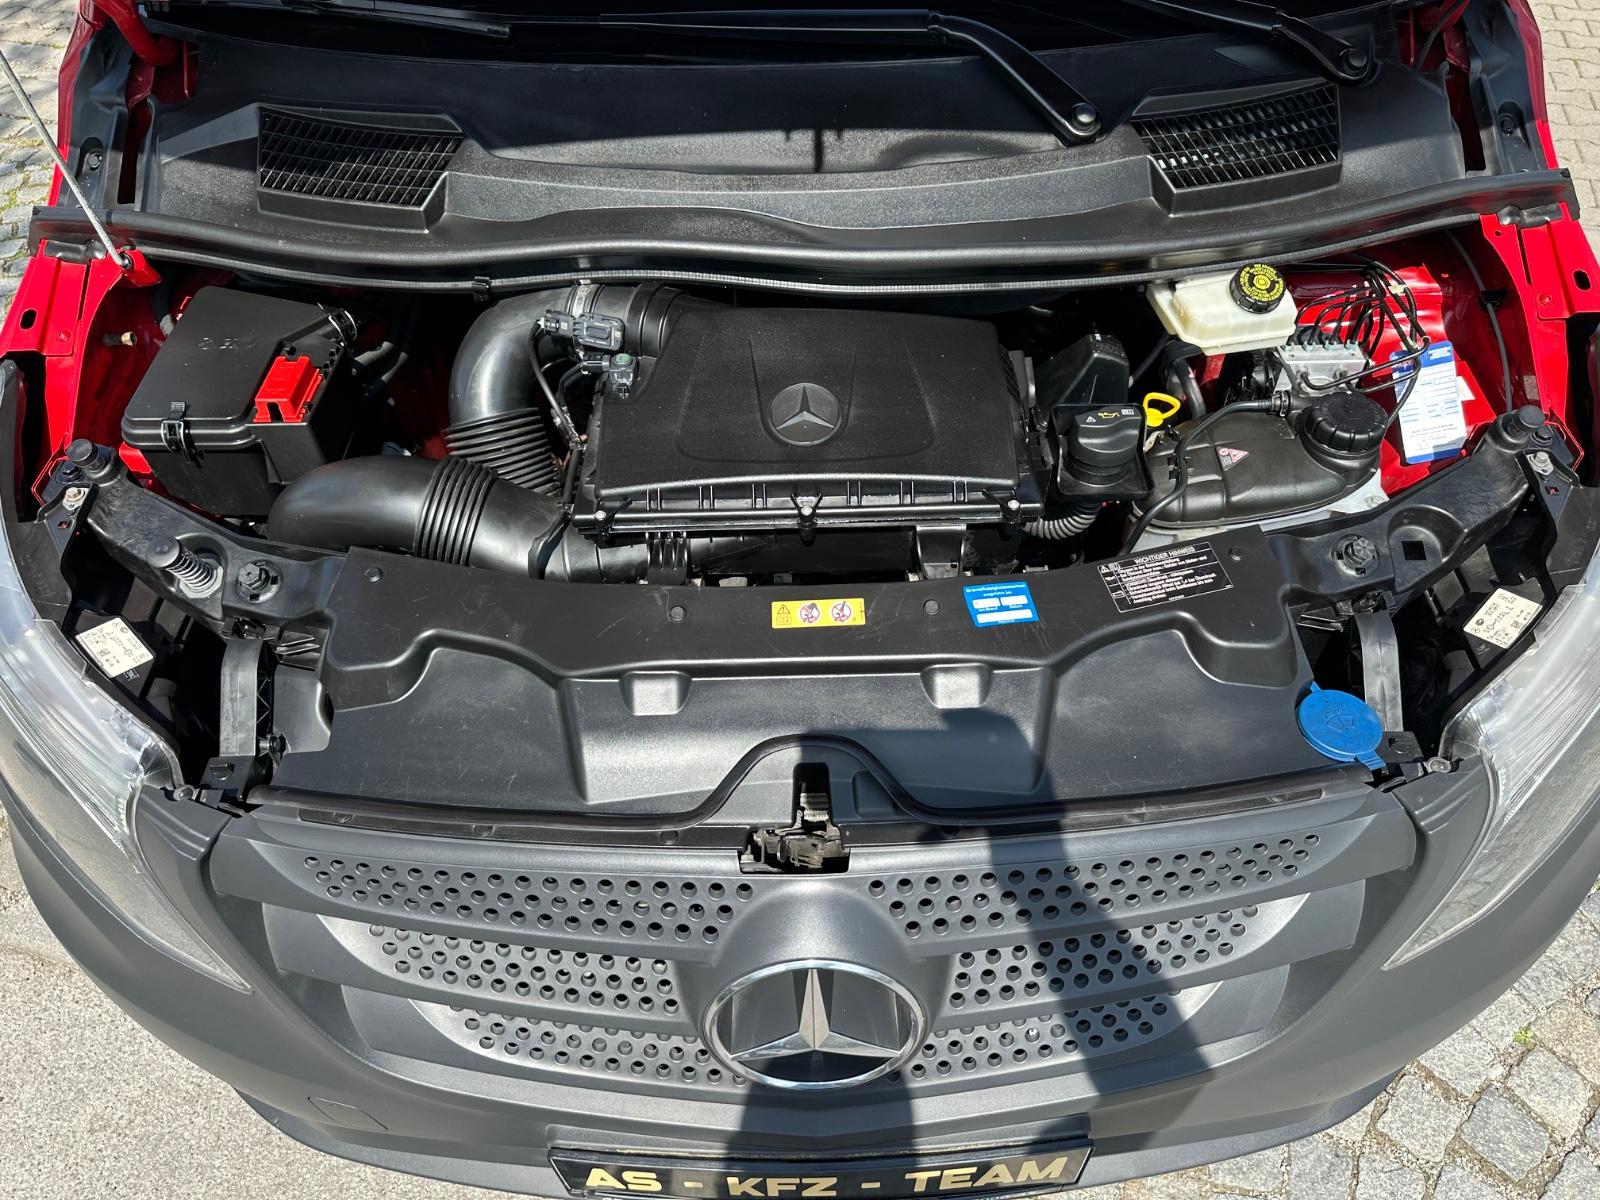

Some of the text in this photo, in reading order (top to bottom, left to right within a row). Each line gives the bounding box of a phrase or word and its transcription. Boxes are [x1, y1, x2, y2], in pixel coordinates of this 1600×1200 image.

[1134, 546, 1195, 564] WICHTIGER HINWEIS
[586, 1167, 662, 1192] AS
[727, 1176, 837, 1197] KFZ
[905, 1157, 1068, 1192] TEAM
